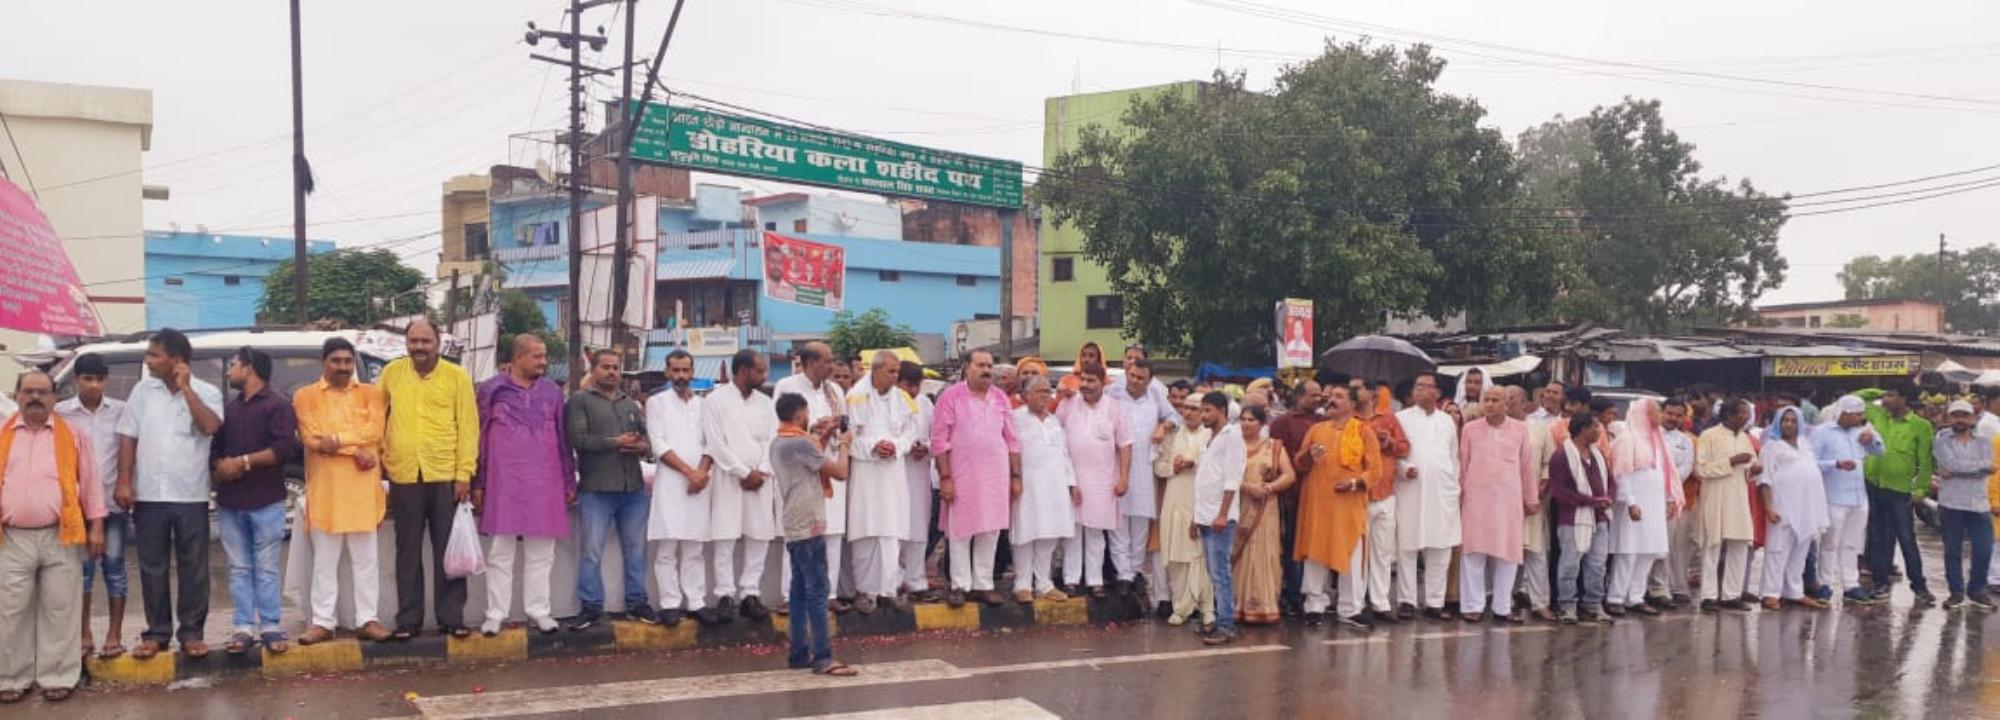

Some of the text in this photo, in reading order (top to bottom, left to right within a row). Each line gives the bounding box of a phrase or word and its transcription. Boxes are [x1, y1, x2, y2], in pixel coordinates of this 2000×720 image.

[686, 129, 798, 163] डोहरिया
[804, 149, 869, 174] कला
[874, 159, 940, 183] शहीद
[946, 170, 984, 190] पथ
